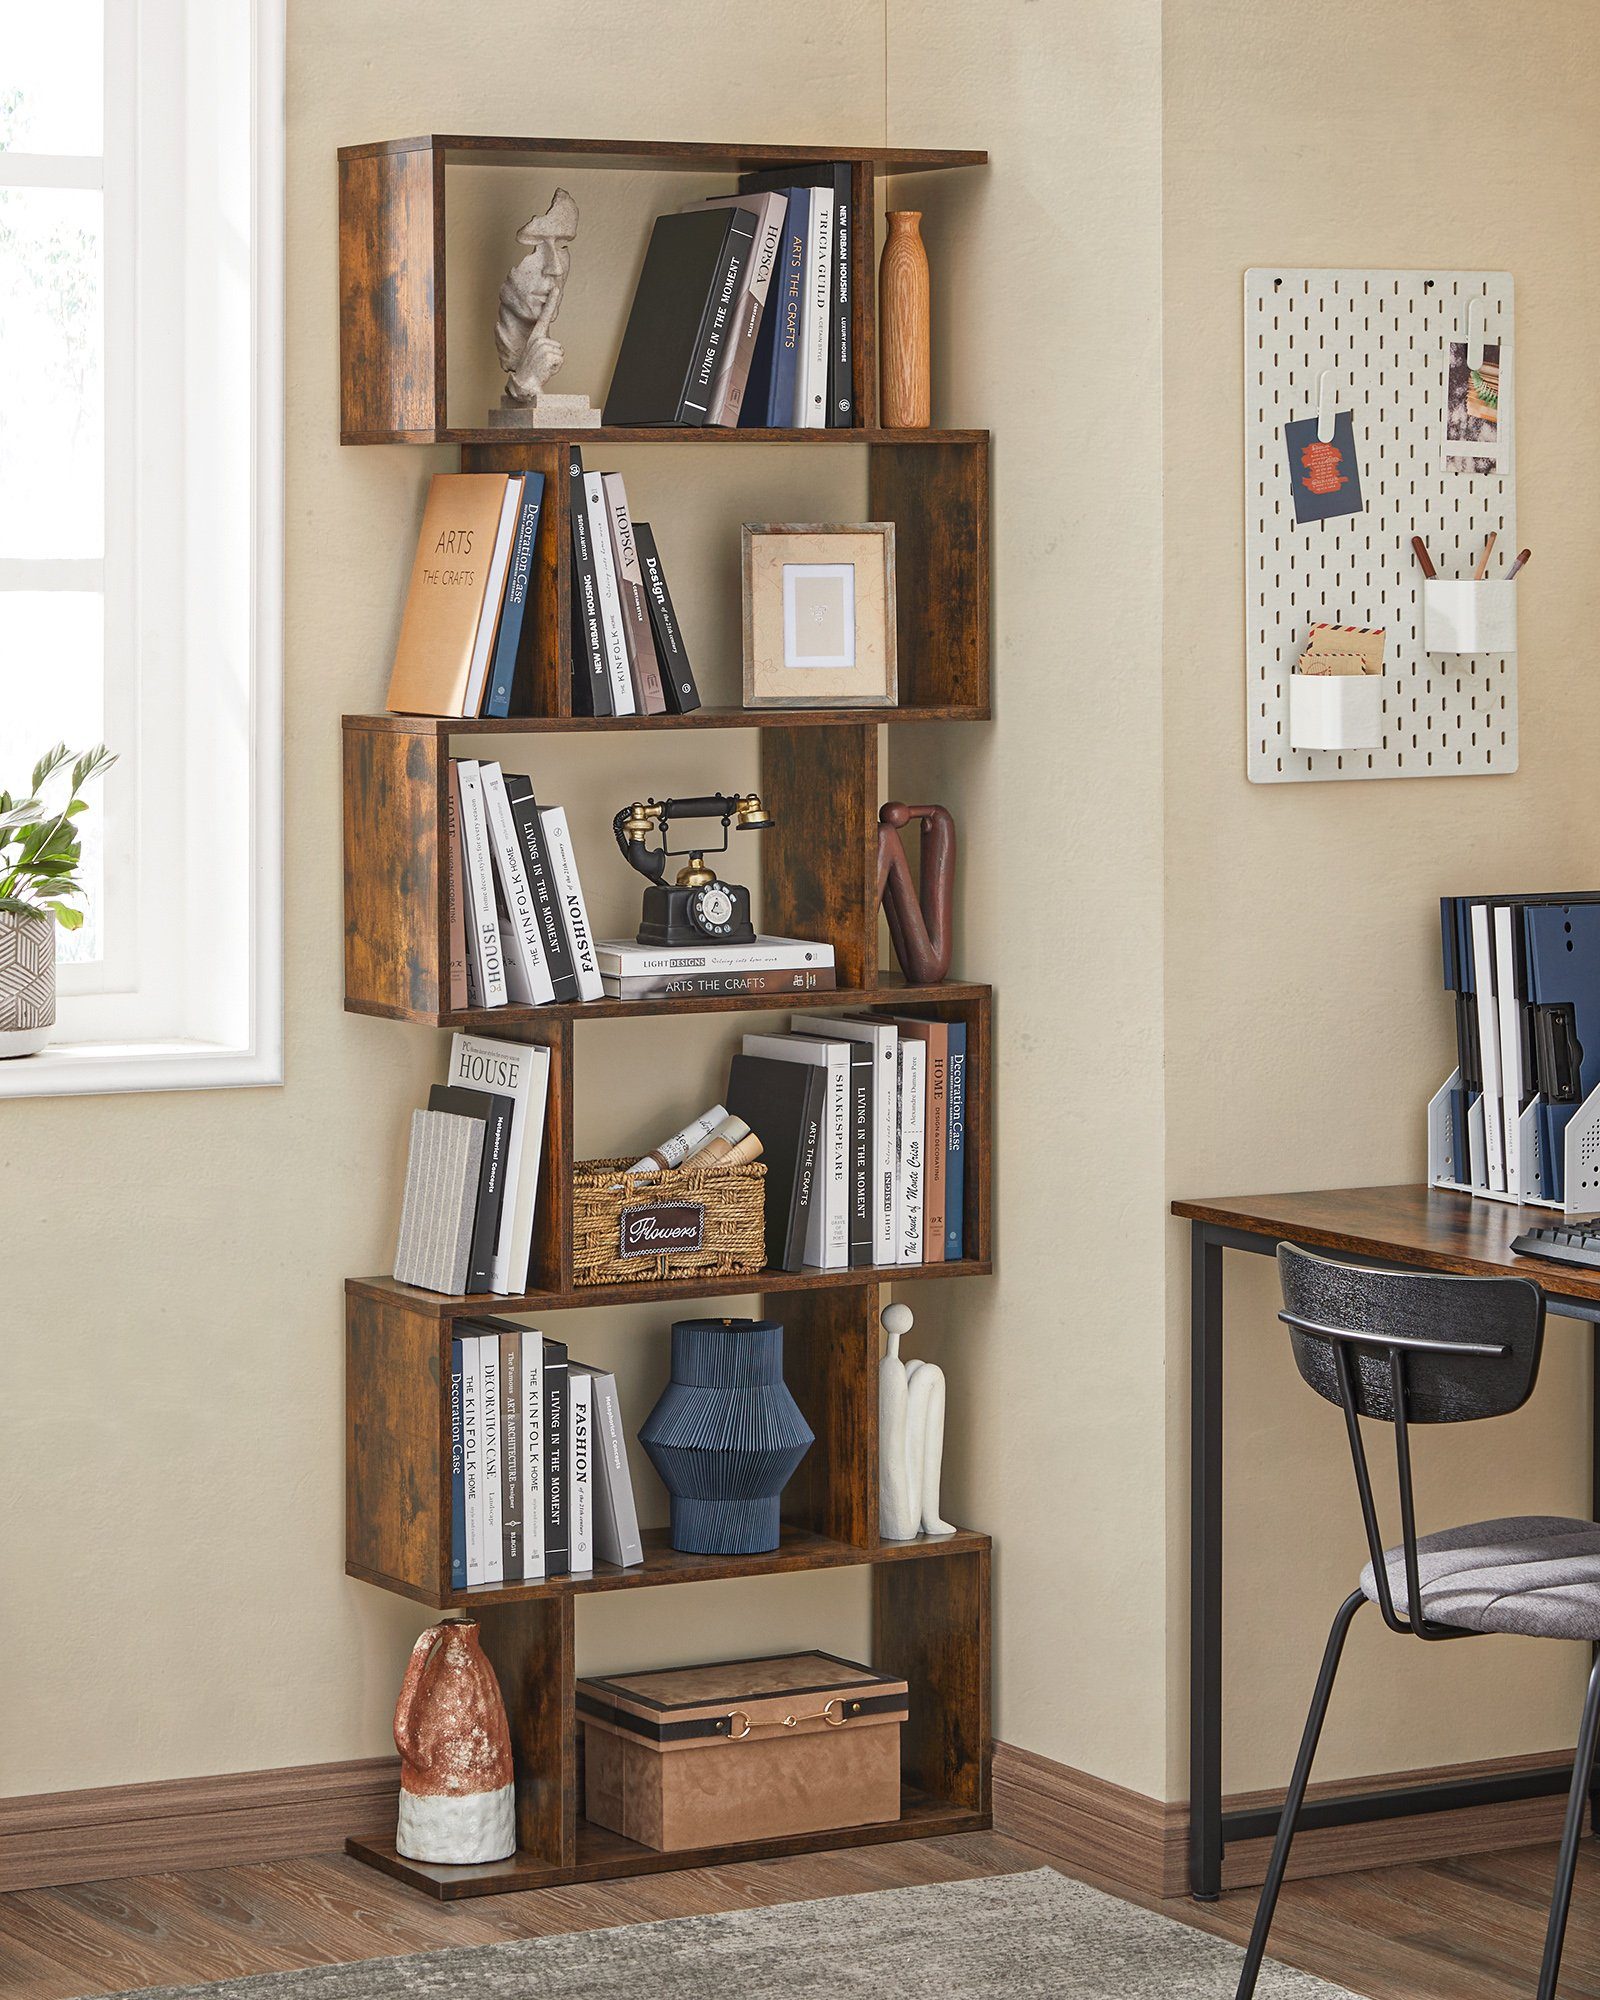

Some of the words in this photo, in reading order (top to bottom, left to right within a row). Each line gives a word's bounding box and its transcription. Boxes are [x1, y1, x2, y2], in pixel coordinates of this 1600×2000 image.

[818, 210, 828, 260] TRICIA
[756, 225, 779, 284] HOPSCA
[791, 236, 802, 267] ARTS
[721, 256, 740, 304] MOMENT
[789, 273, 800, 298] THE
[817, 264, 827, 308] GUILD
[840, 263, 848, 303] HOUSING
[714, 306, 727, 328] THE
[784, 302, 798, 348] CRAFTS
[710, 332, 720, 344] IN
[699, 348, 716, 385] LIVING
[434, 530, 474, 554] ARTS
[520, 504, 538, 572] Decoration
[580, 536, 588, 560] LUXURY
[616, 505, 634, 568] HOPSCA
[422, 570, 440, 584] THE
[442, 570, 474, 586] CRAFTS
[514, 574, 528, 604] Case
[584, 574, 596, 616] HOUSING
[646, 557, 665, 604] Design
[660, 606, 668, 614] of
[669, 634, 678, 654] century
[589, 618, 600, 650] URBAN
[593, 652, 602, 674] NEW
[611, 630, 625, 682] KINFOLK
[524, 822, 540, 860] LIVING
[506, 846, 518, 872] HOME
[532, 864, 543, 876] IN
[480, 872, 488, 891] decor
[536, 878, 548, 903] THE
[512, 874, 536, 944] KINFOLK
[542, 906, 560, 954] MOMENT
[566, 894, 594, 973] FASHION
[482, 922, 501, 983] HOUSE
[530, 948, 540, 966] THE
[643, 960, 668, 968] LIGHT
[670, 958, 706, 968] DESIGNS
[666, 980, 693, 992] ARTS
[698, 979, 720, 990] THE
[724, 978, 765, 990] CRAFTS
[459, 1053, 520, 1088] HOUSE
[934, 1059, 944, 1100] HOME
[954, 1054, 964, 1120] Decoration
[858, 1087, 866, 1124] LIVING
[494, 1116, 504, 1160] Metaphorical
[808, 1121, 818, 1145] ARTS
[834, 1074, 844, 1181] SHAKESPEARE
[858, 1129, 866, 1140] IN
[953, 1122, 962, 1151] Case
[805, 1148, 814, 1167] THE
[858, 1144, 866, 1167] THE
[906, 1141, 920, 1168] Cristo
[488, 1162, 498, 1193] Concepts
[800, 1170, 811, 1206] CRAFTS
[884, 1172, 892, 1212] DESIGNS
[906, 1170, 918, 1200] Monte
[858, 1172, 866, 1218] MOMENT
[907, 1205, 921, 1214] of
[630, 1216, 697, 1243] Flowers
[905, 1215, 919, 1239] Count
[904, 1242, 917, 1257] The
[466, 1376, 474, 1394] THE
[530, 1368, 538, 1386] THE
[452, 1373, 462, 1442] Decoration
[484, 1364, 496, 1446] DECORATION
[508, 1397, 516, 1414] ART
[552, 1390, 560, 1429] LIVING
[466, 1398, 476, 1471] KINFOLK
[529, 1391, 538, 1463] KINFOLK
[552, 1433, 560, 1445] IN
[606, 1396, 616, 1438] Metaphorical
[612, 1438, 620, 1470] Concepts
[452, 1444, 462, 1474] Case
[508, 1420, 516, 1482] ARCHITECTURE
[576, 1403, 586, 1484] FASHION
[486, 1448, 497, 1480] CASE
[552, 1448, 560, 1472] THE
[468, 1474, 476, 1500] HOME
[552, 1478, 560, 1526] MOMENT
